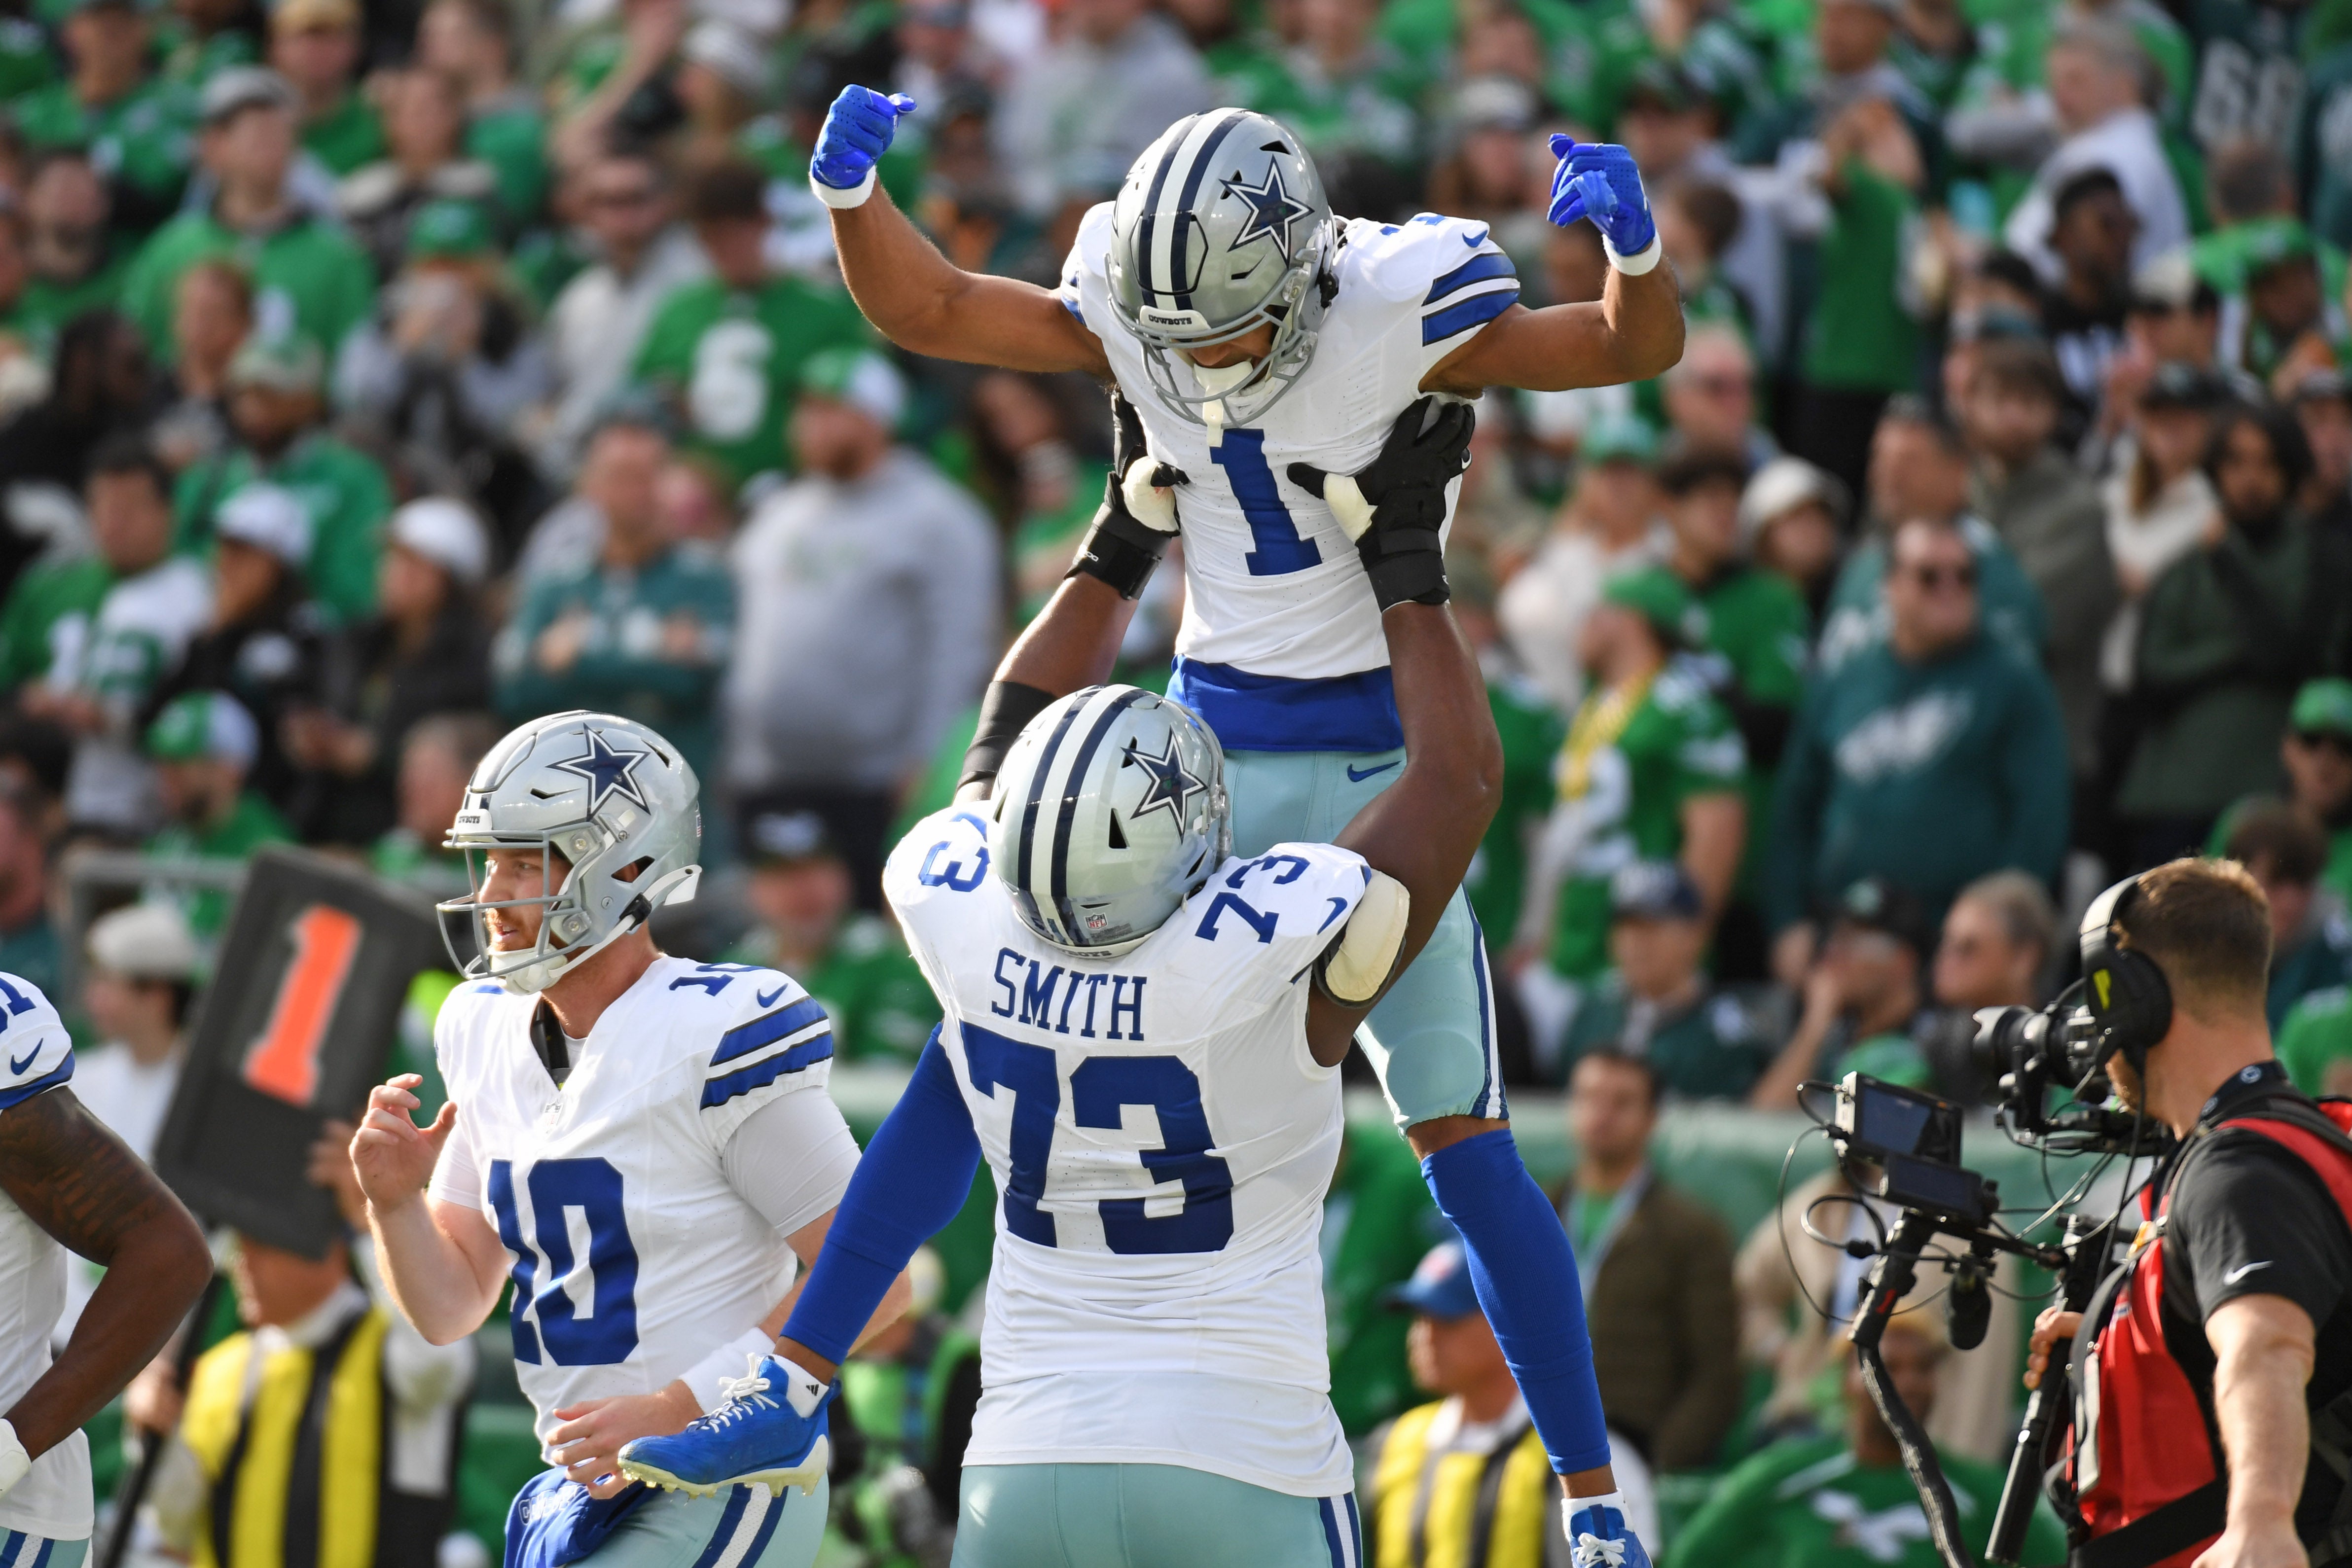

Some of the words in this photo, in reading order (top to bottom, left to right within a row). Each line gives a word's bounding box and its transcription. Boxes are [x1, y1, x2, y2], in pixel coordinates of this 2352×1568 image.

[1148, 314, 1193, 325] COWBOYS
[1209, 428, 1323, 575] 1
[1194, 855, 1311, 944] 73
[243, 901, 364, 1107] 1
[991, 947, 1147, 1041] SMITH
[959, 1018, 1234, 1255] 73
[487, 1156, 639, 1366] 10
